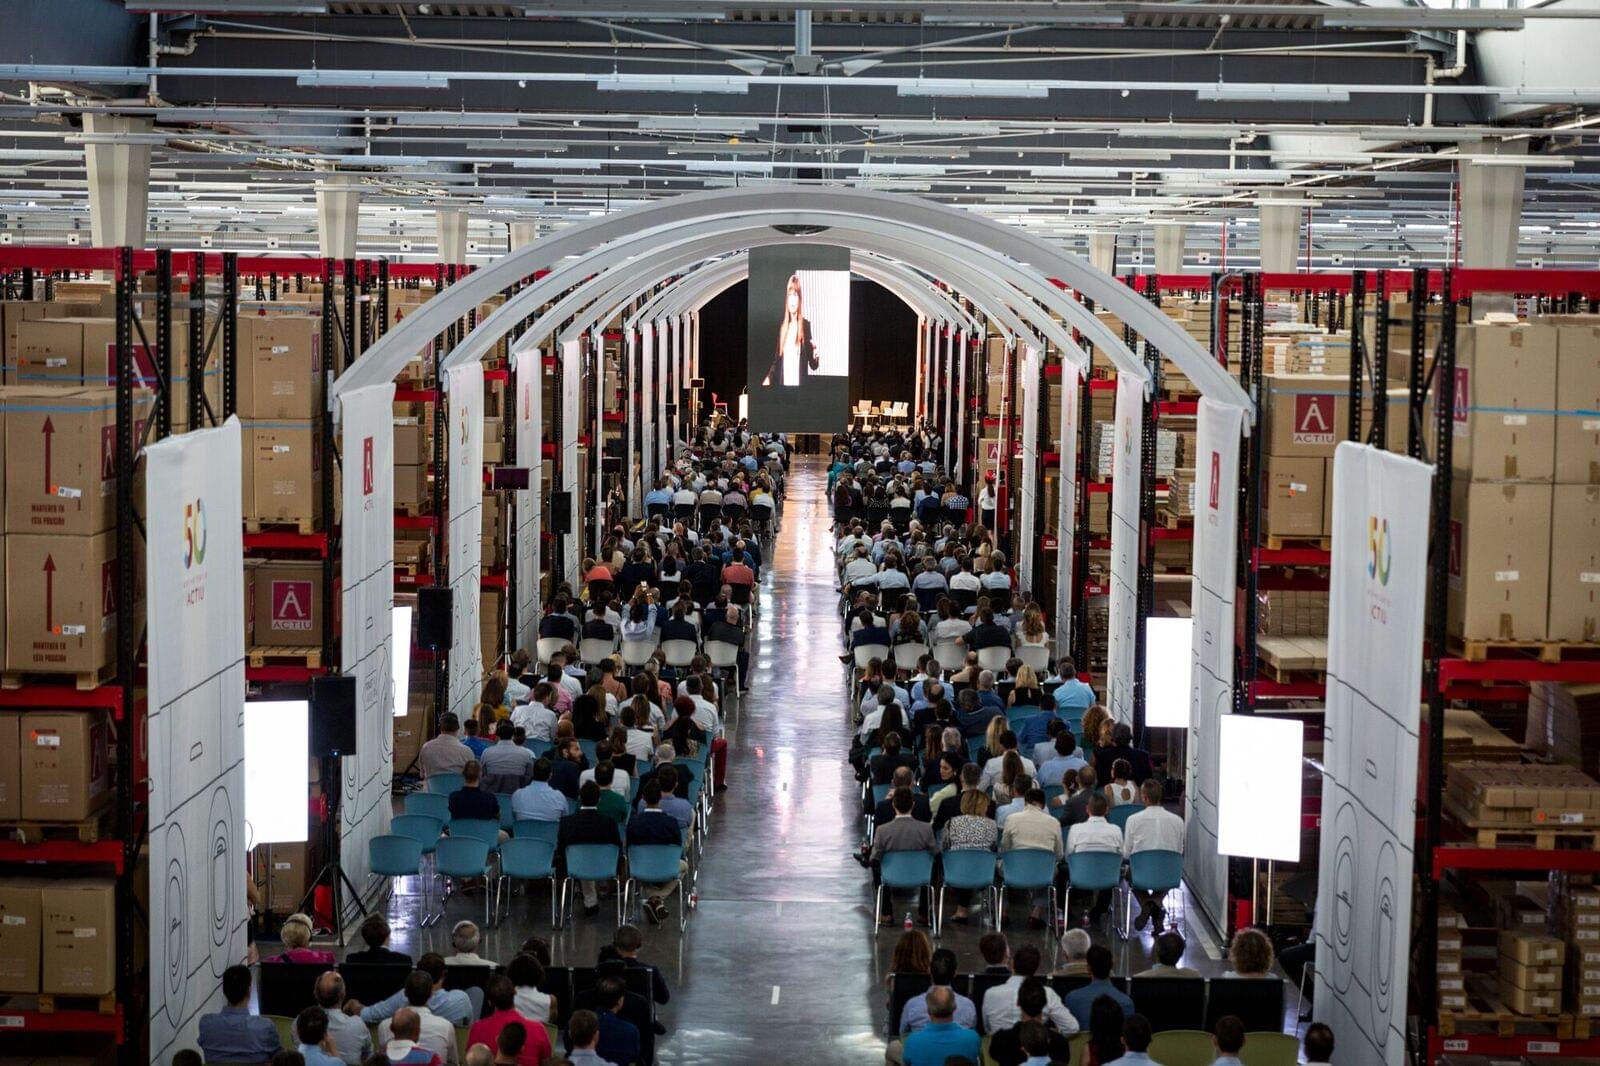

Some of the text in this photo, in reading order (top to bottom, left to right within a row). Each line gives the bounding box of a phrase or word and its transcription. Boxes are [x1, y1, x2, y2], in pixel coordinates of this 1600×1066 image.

[1295, 434, 1335, 443] ACTIU
[184, 497, 207, 570] 50
[1368, 515, 1391, 587] 50
[187, 586, 205, 607] ACTIU
[272, 620, 312, 629] ACTIU
